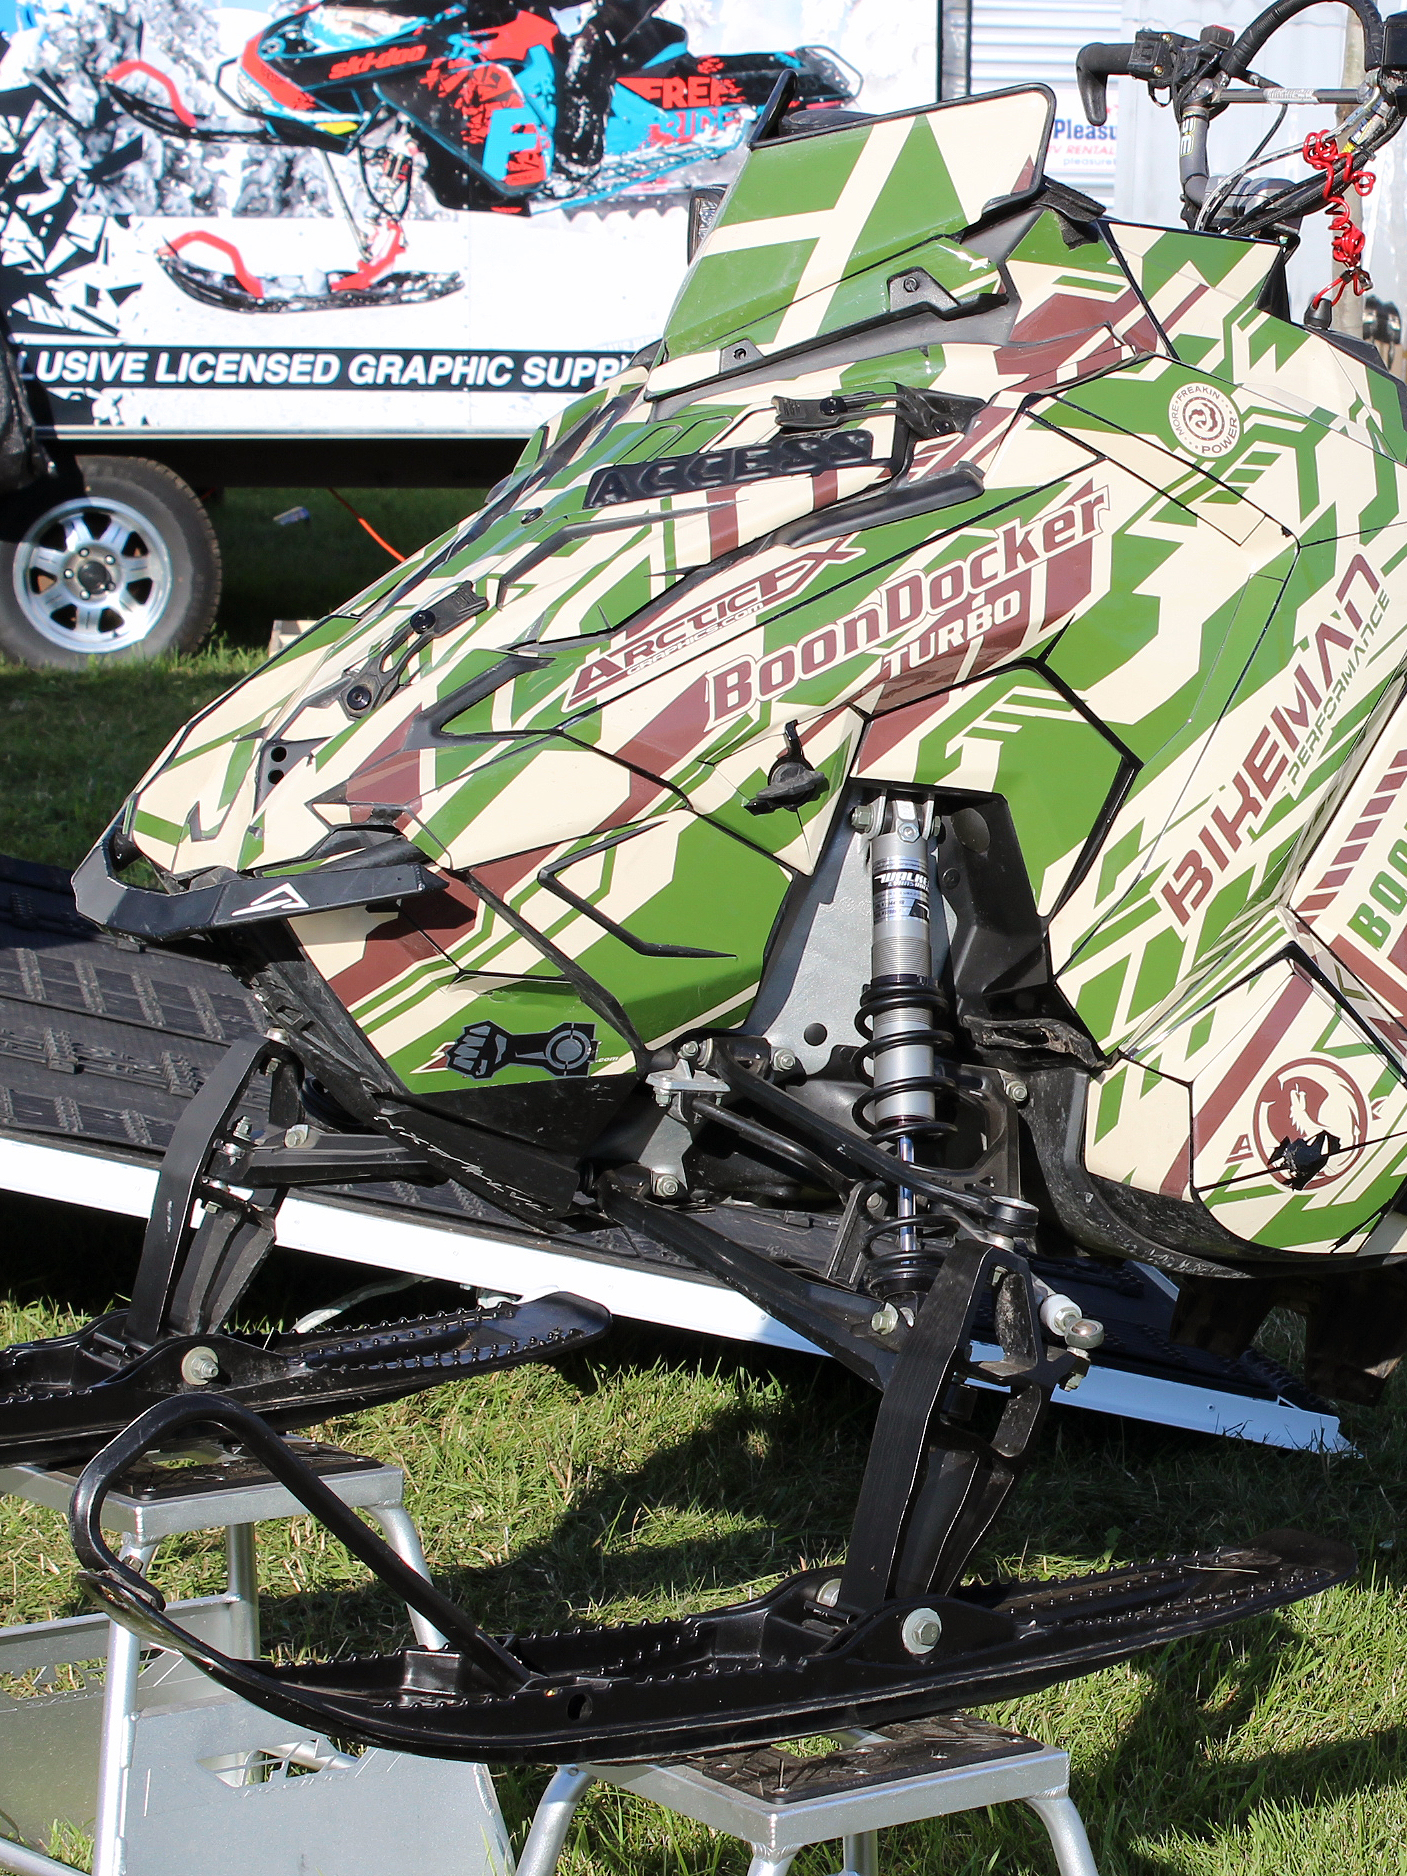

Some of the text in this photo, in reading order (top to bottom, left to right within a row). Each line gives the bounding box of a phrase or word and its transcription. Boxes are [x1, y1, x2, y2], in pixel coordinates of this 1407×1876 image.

[329, 45, 427, 80] ski-doo
[155, 352, 341, 385] LICENSED
[348, 354, 515, 387] GRAPHIC
[1176, 385, 1221, 402] FREAKIN
[1171, 404, 1185, 436] MORE
[1201, 417, 1238, 454] POWER
[585, 429, 872, 508] ACCESS
[884, 589, 1023, 679] TURBO
[1287, 588, 1391, 786] PERFORMANCE
